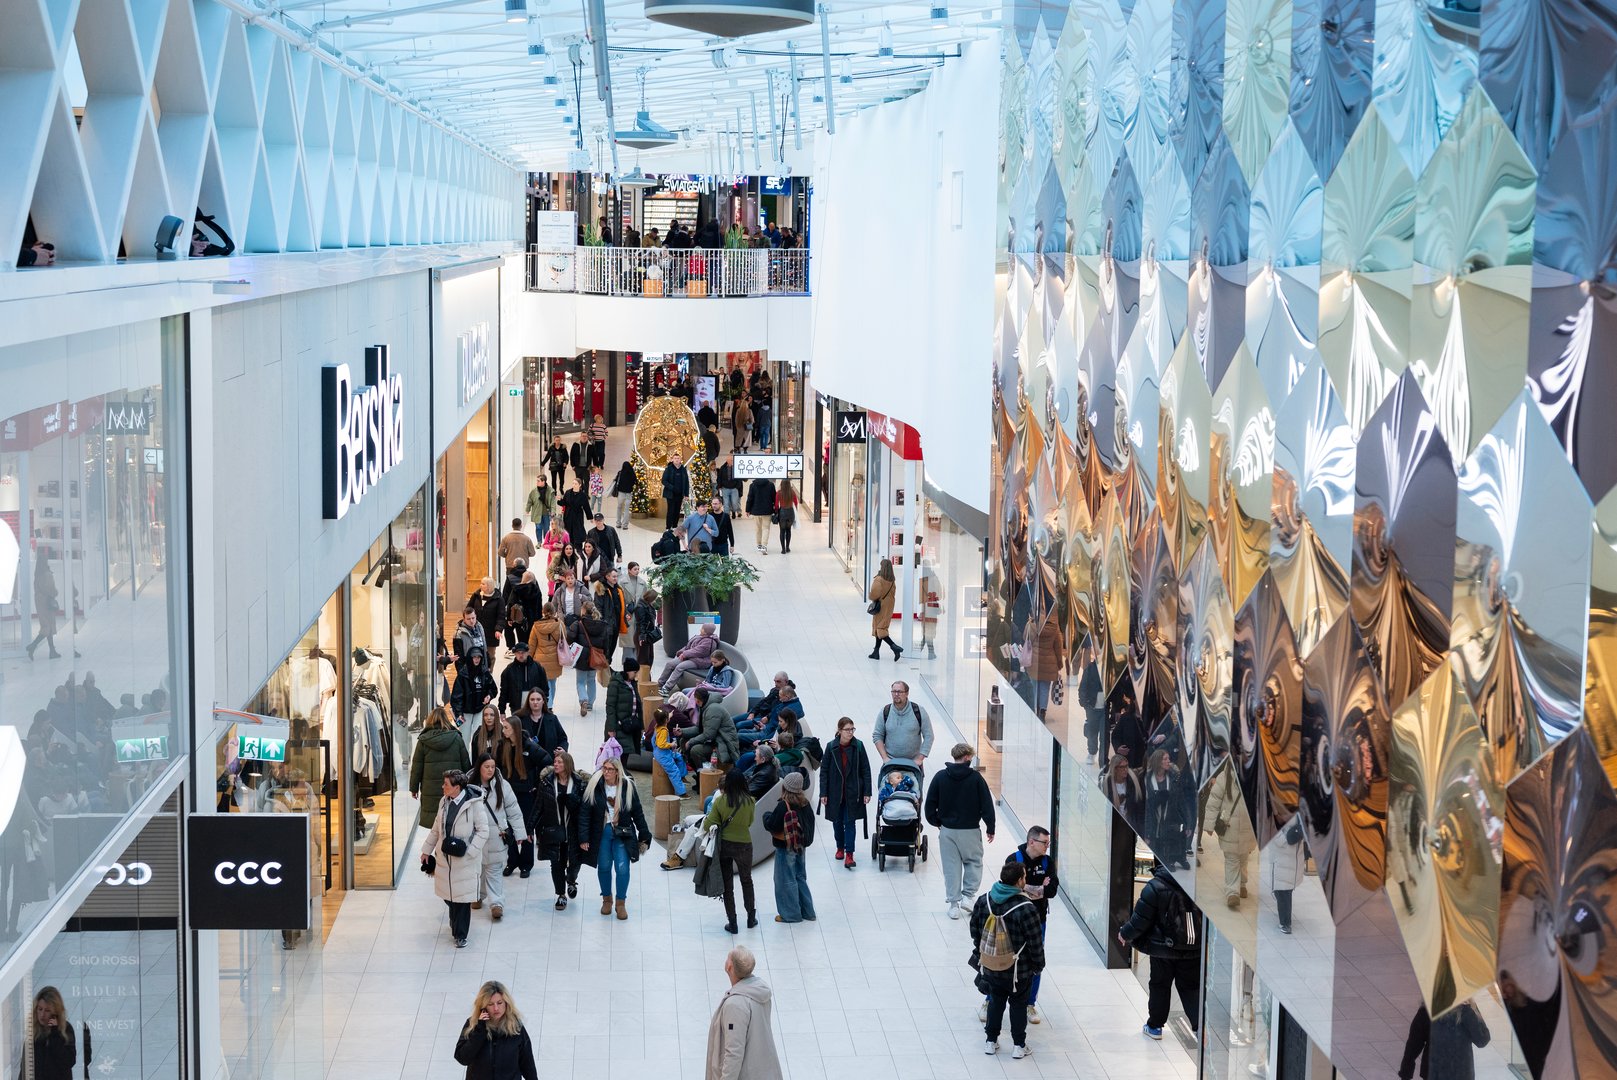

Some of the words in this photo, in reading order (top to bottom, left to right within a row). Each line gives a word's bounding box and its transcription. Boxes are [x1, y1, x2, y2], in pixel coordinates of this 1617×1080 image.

[594, 382, 602, 392] %
[626, 378, 634, 389] %
[333, 344, 403, 520] Bershka
[214, 861, 282, 885] CCC
[69, 956, 99, 965] GINO
[102, 956, 140, 965] ROSSI
[72, 986, 138, 997] BADURA
[76, 1020, 102, 1030] NINE
[106, 1020, 136, 1030] WEST
